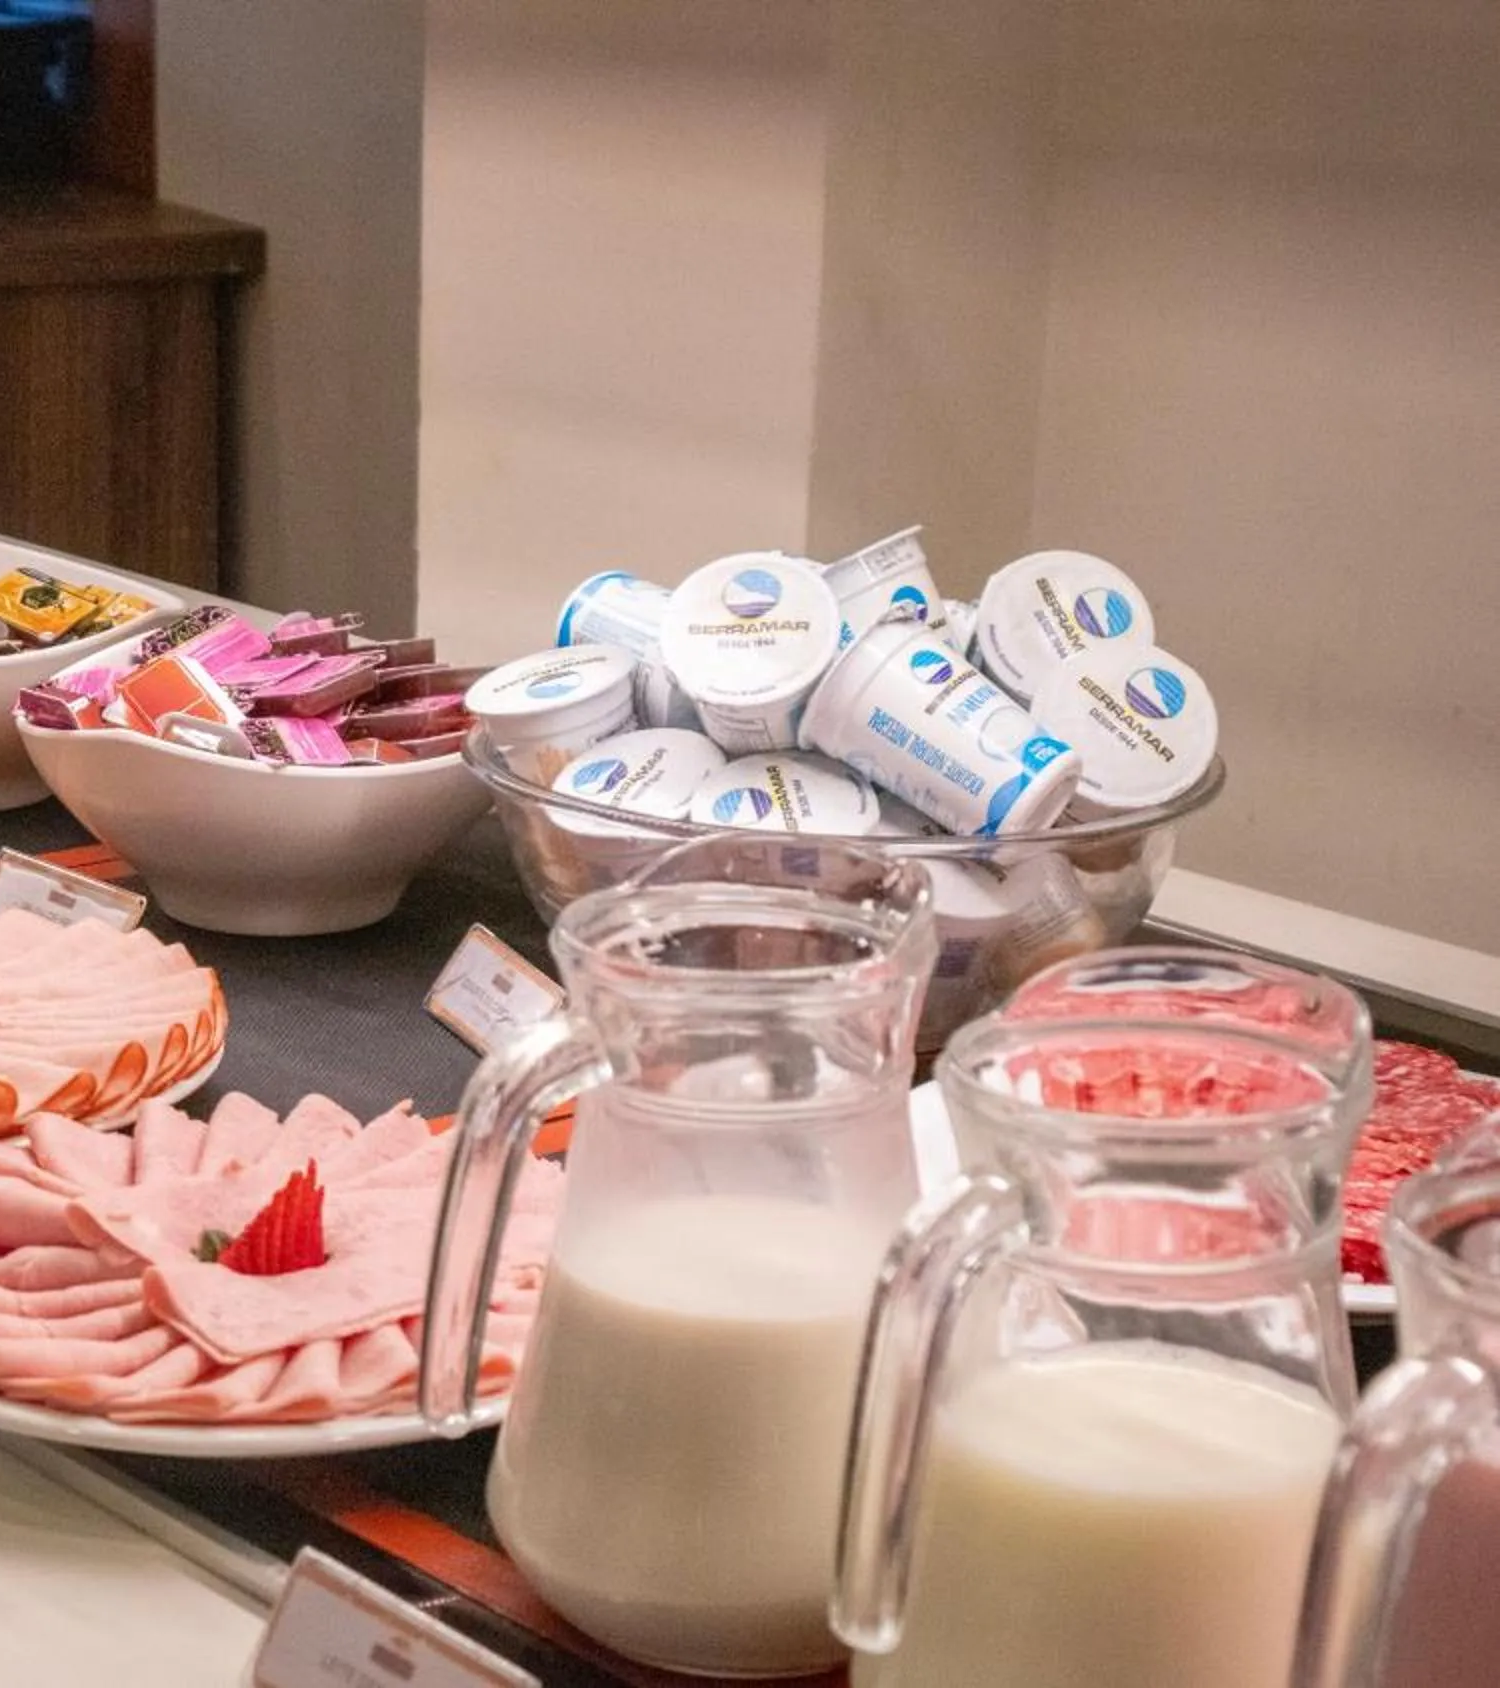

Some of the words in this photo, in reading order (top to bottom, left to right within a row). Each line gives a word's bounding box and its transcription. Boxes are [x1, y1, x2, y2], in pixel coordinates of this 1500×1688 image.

[688, 620, 810, 636] SERRAMAR
[1036, 577, 1086, 653] SERRAM
[1078, 676, 1176, 764] SERRAMAR
[765, 764, 799, 832] ERRAMAR
